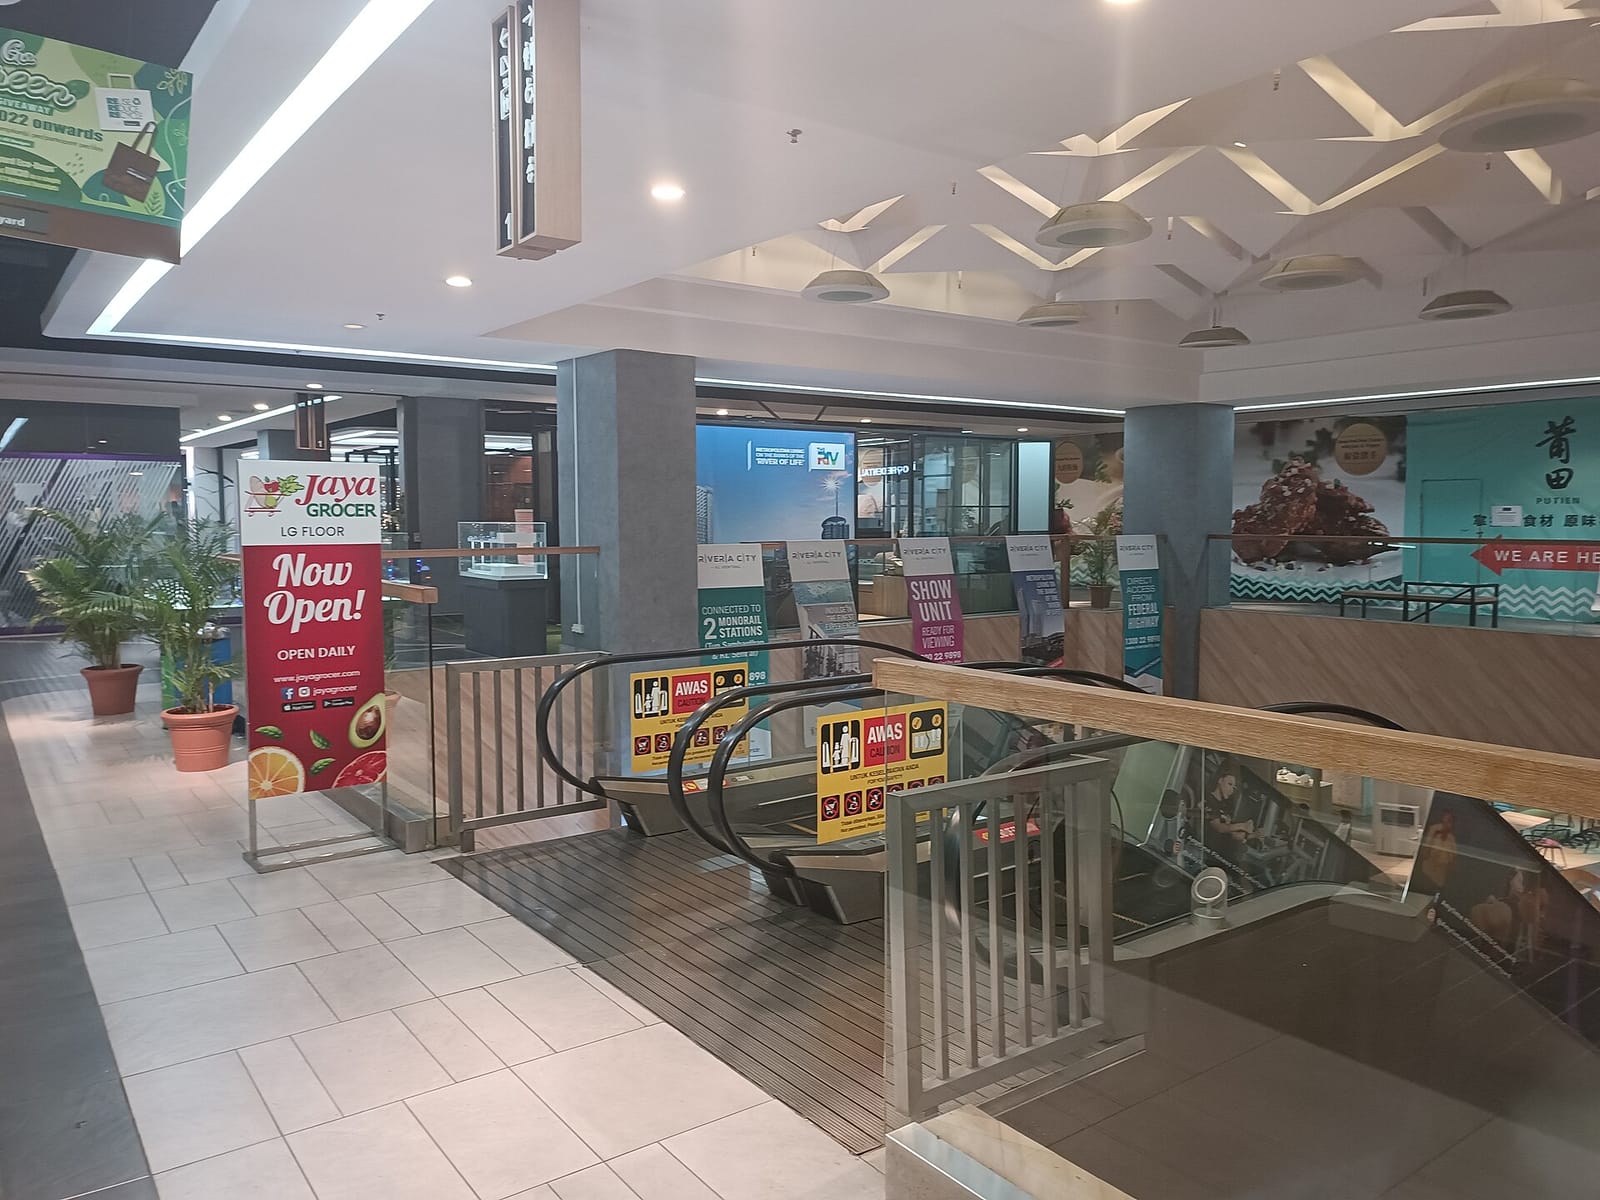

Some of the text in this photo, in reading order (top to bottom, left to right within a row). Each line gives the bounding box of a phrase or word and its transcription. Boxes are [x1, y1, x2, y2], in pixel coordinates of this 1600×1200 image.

[33, 119, 103, 142] onwards
[295, 475, 376, 505] Jaya
[306, 503, 377, 517] GROCER
[281, 527, 345, 537] LG FLOOR
[736, 553, 757, 562] CITY
[1494, 550, 1521, 562] WE
[1529, 551, 1568, 562] ARE
[272, 553, 352, 587] Now
[911, 579, 952, 601] SHOW
[263, 590, 366, 634] Open!
[702, 604, 761, 615] CONNECTED TO
[918, 601, 953, 622] UNIT
[1128, 602, 1159, 615] FEDERAL
[718, 615, 762, 626] MONORAIL
[703, 617, 717, 640] 2
[719, 625, 763, 638] STATIONS
[922, 624, 955, 636] READY FOR
[922, 635, 955, 649] VIEWING
[277, 645, 356, 660] OPEN DAILY
[934, 652, 943, 660] 22
[675, 680, 708, 696] AWAS
[867, 723, 902, 744] AWAS
